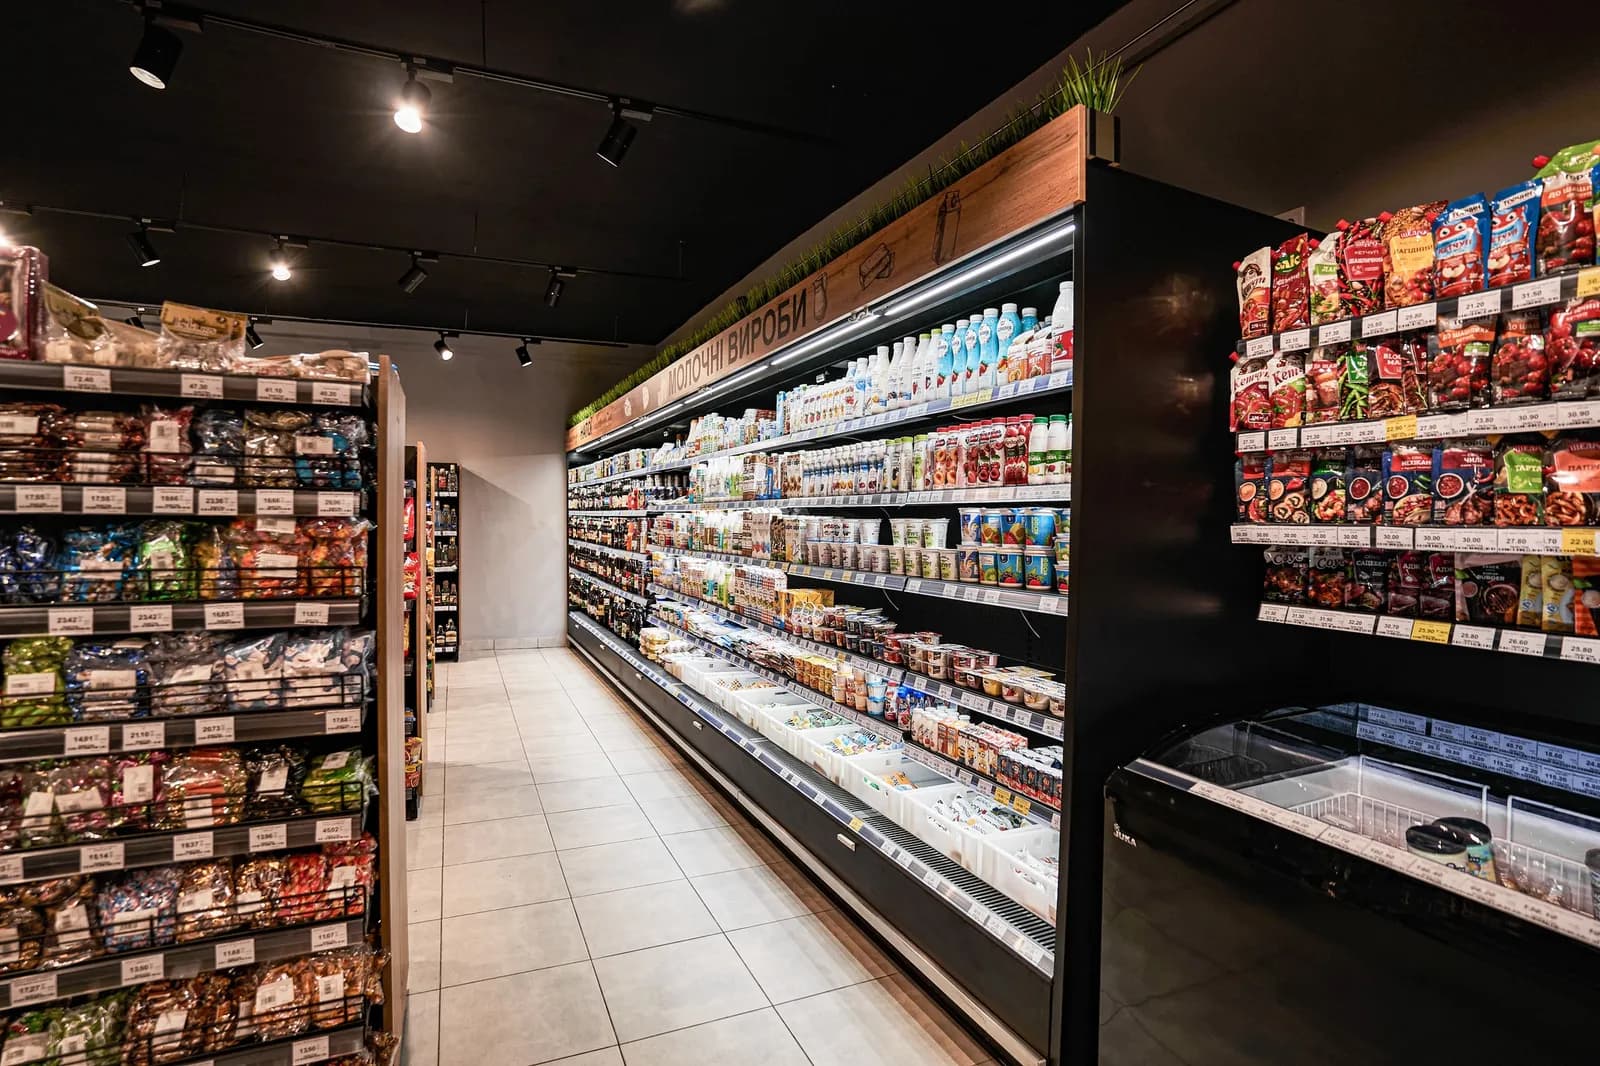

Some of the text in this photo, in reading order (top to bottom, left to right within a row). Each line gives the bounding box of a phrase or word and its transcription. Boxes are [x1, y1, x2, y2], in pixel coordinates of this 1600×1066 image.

[668, 288, 806, 396] МОЛОЧНІ ВИРОБИ
[1515, 464, 1542, 472] ТАРТА
[1113, 830, 1137, 847] JUKA
